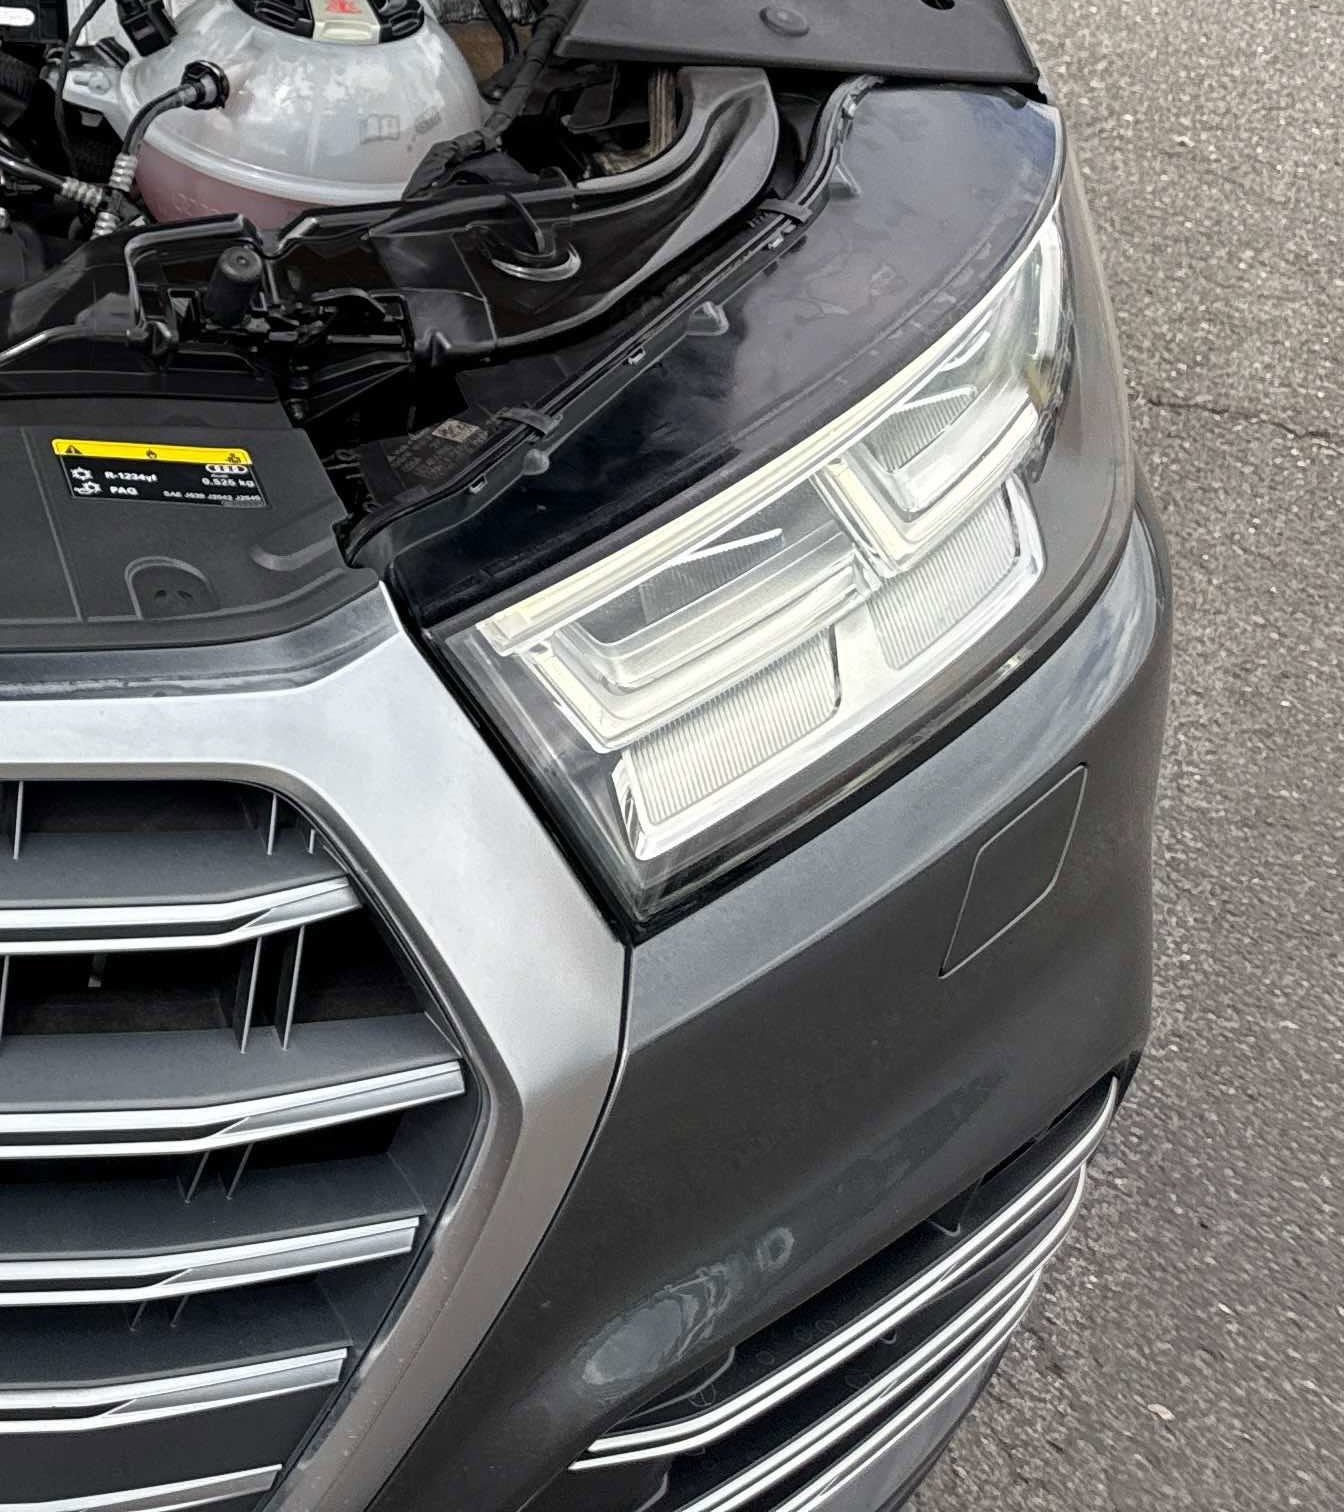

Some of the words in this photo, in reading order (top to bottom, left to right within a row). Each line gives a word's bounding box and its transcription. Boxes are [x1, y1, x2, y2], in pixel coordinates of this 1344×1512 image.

[104, 471, 158, 483] R-1234yf
[238, 479, 255, 488] kg
[109, 485, 139, 496] PAG
